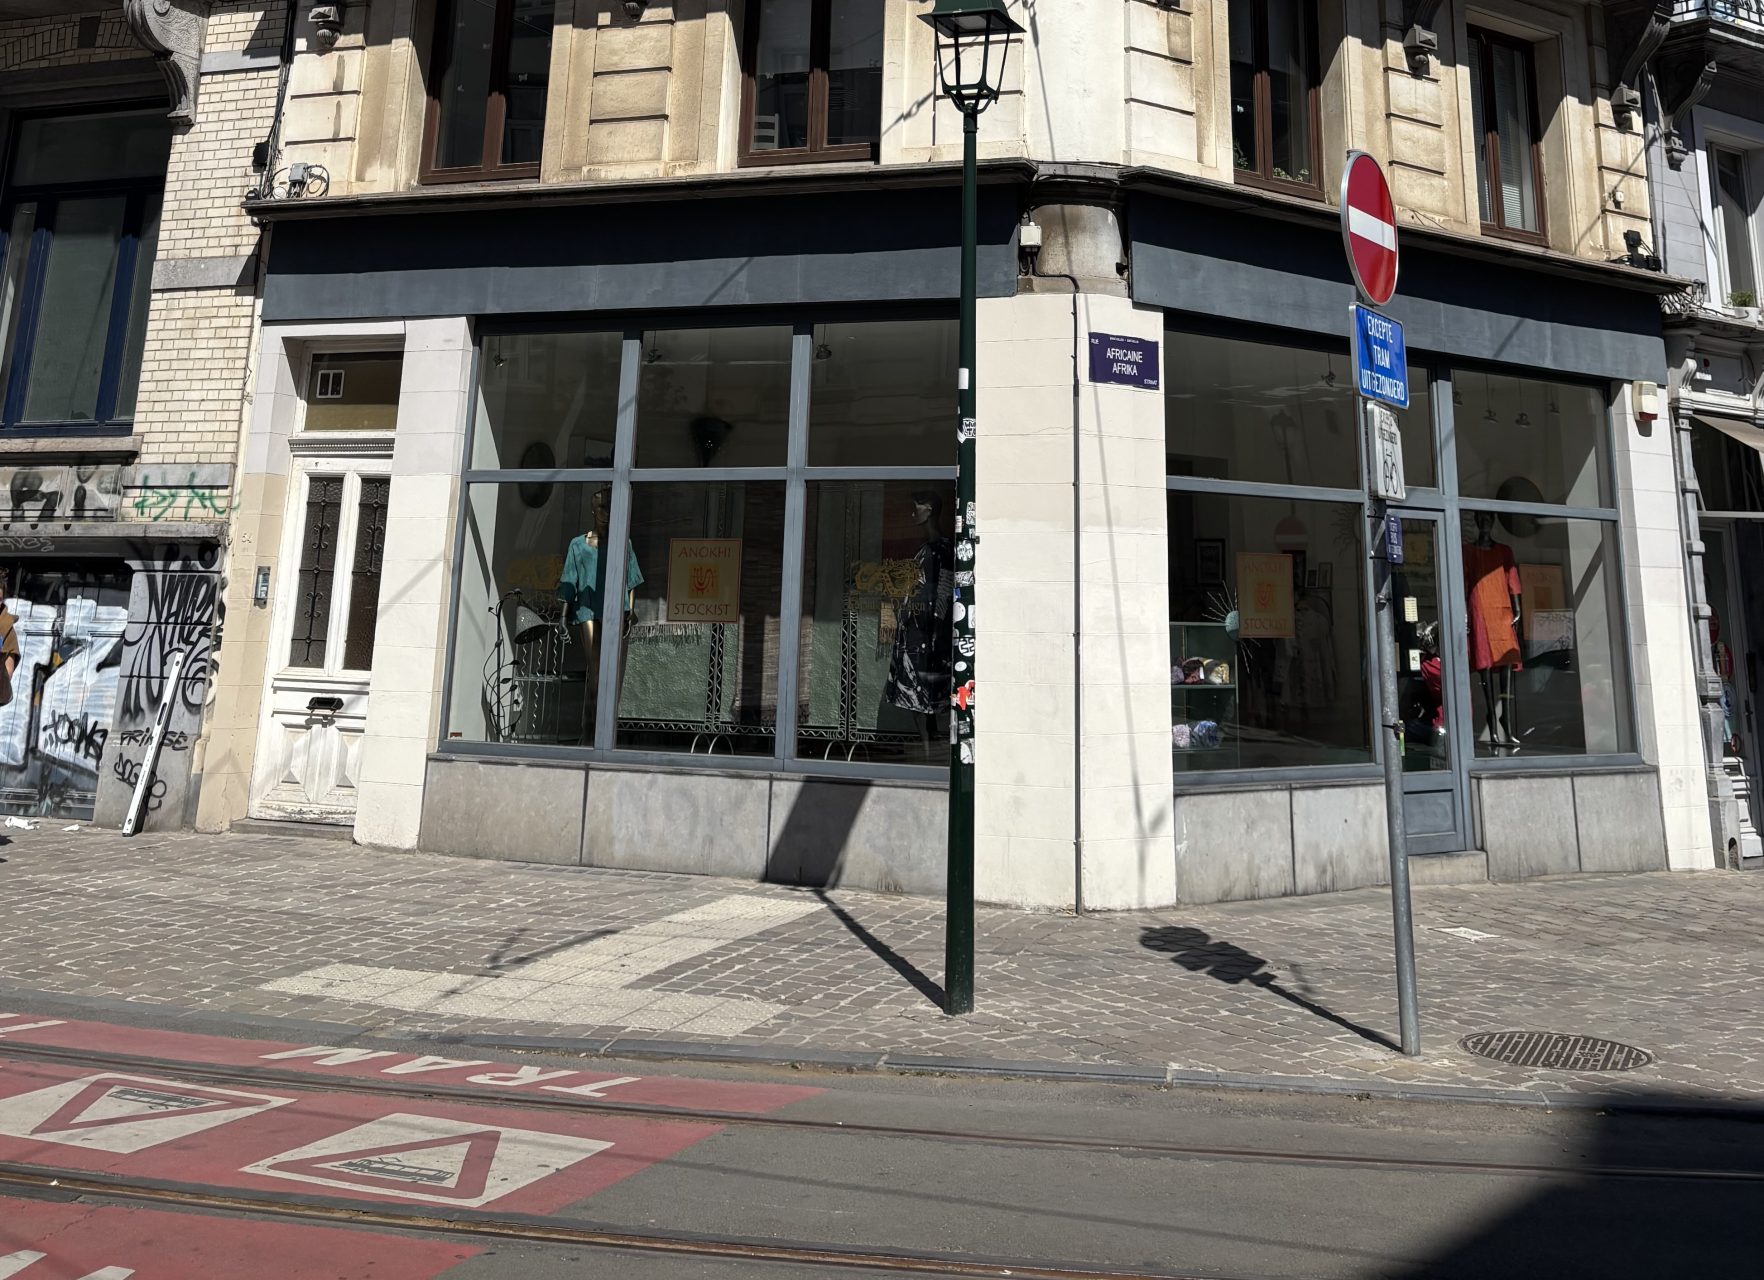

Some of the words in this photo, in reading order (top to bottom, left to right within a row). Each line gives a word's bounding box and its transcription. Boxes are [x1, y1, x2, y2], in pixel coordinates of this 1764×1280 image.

[1367, 315, 1393, 344] EXCEPTE
[1106, 347, 1143, 363] AFRICAINE
[1373, 345, 1391, 370] TRAM
[1112, 363, 1138, 376] AFRIKA
[1361, 368, 1405, 401] UITGEZONDERD
[678, 546, 731, 559] ANOKHI
[673, 602, 730, 617] STOCKIST
[1243, 618, 1288, 631] STOCKIST
[258, 1045, 642, 1098] TRAM
